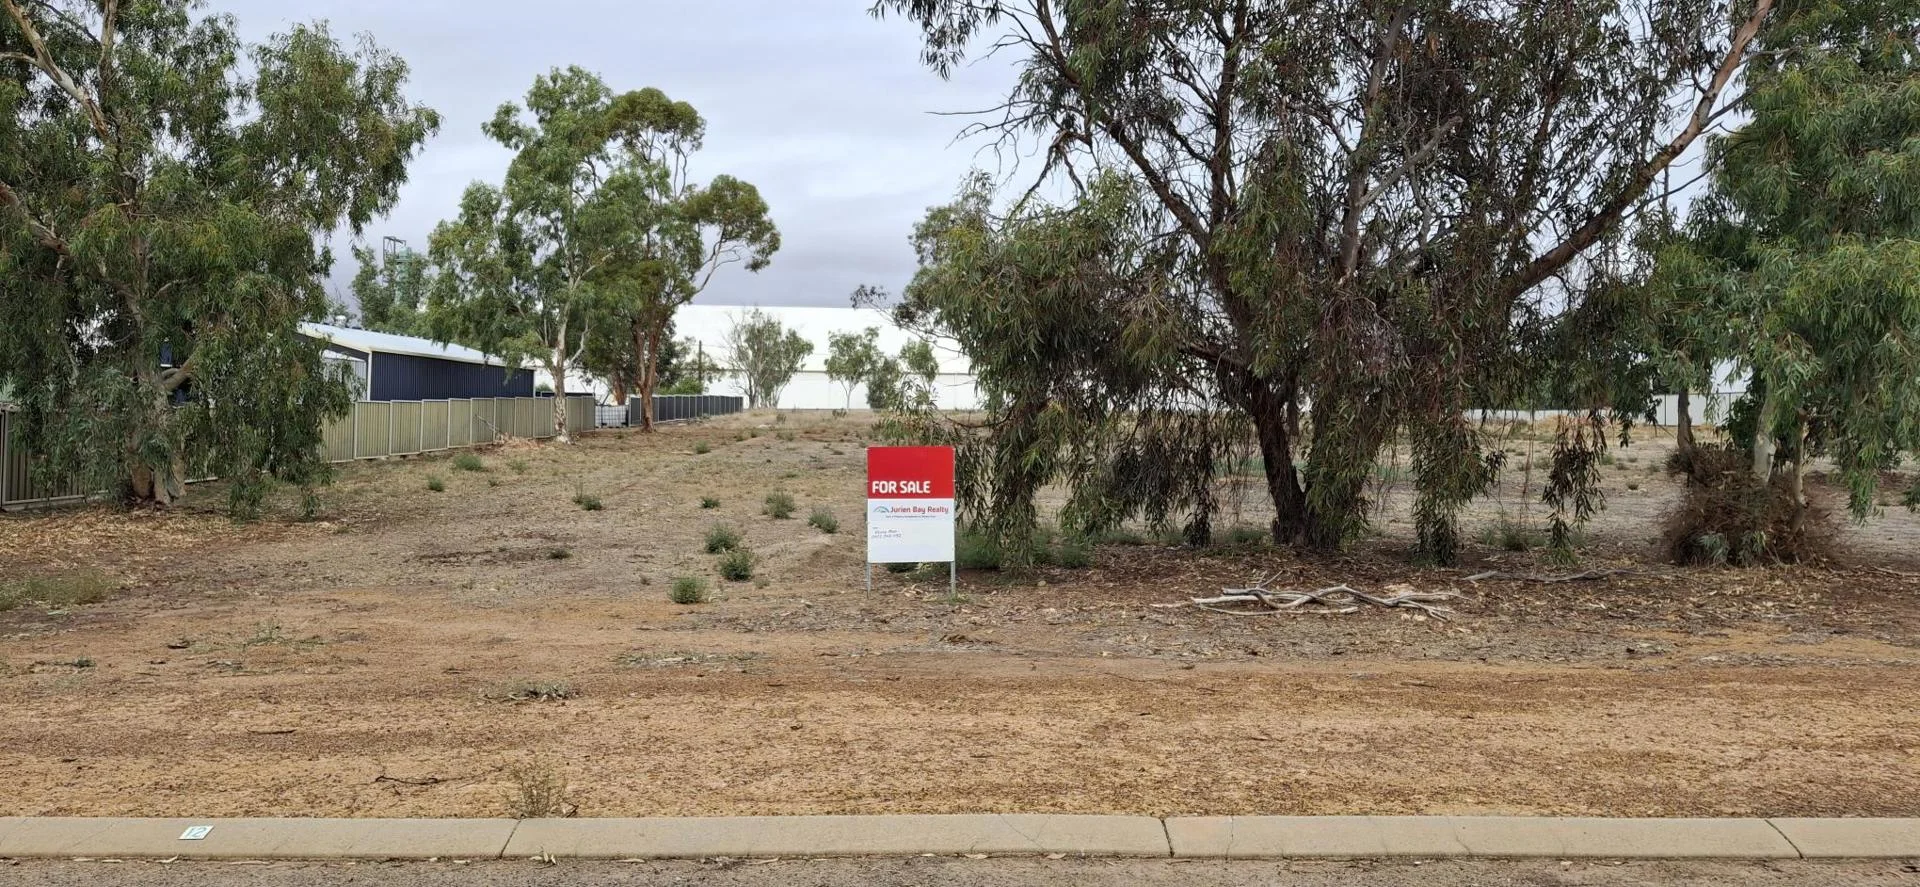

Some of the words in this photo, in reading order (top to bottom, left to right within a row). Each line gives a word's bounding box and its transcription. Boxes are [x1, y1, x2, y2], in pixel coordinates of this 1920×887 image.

[872, 481, 897, 493] FOR
[900, 481, 931, 493] SALE
[912, 506, 926, 514] Bay
[928, 506, 949, 514] Realty
[185, 827, 207, 837] 12
